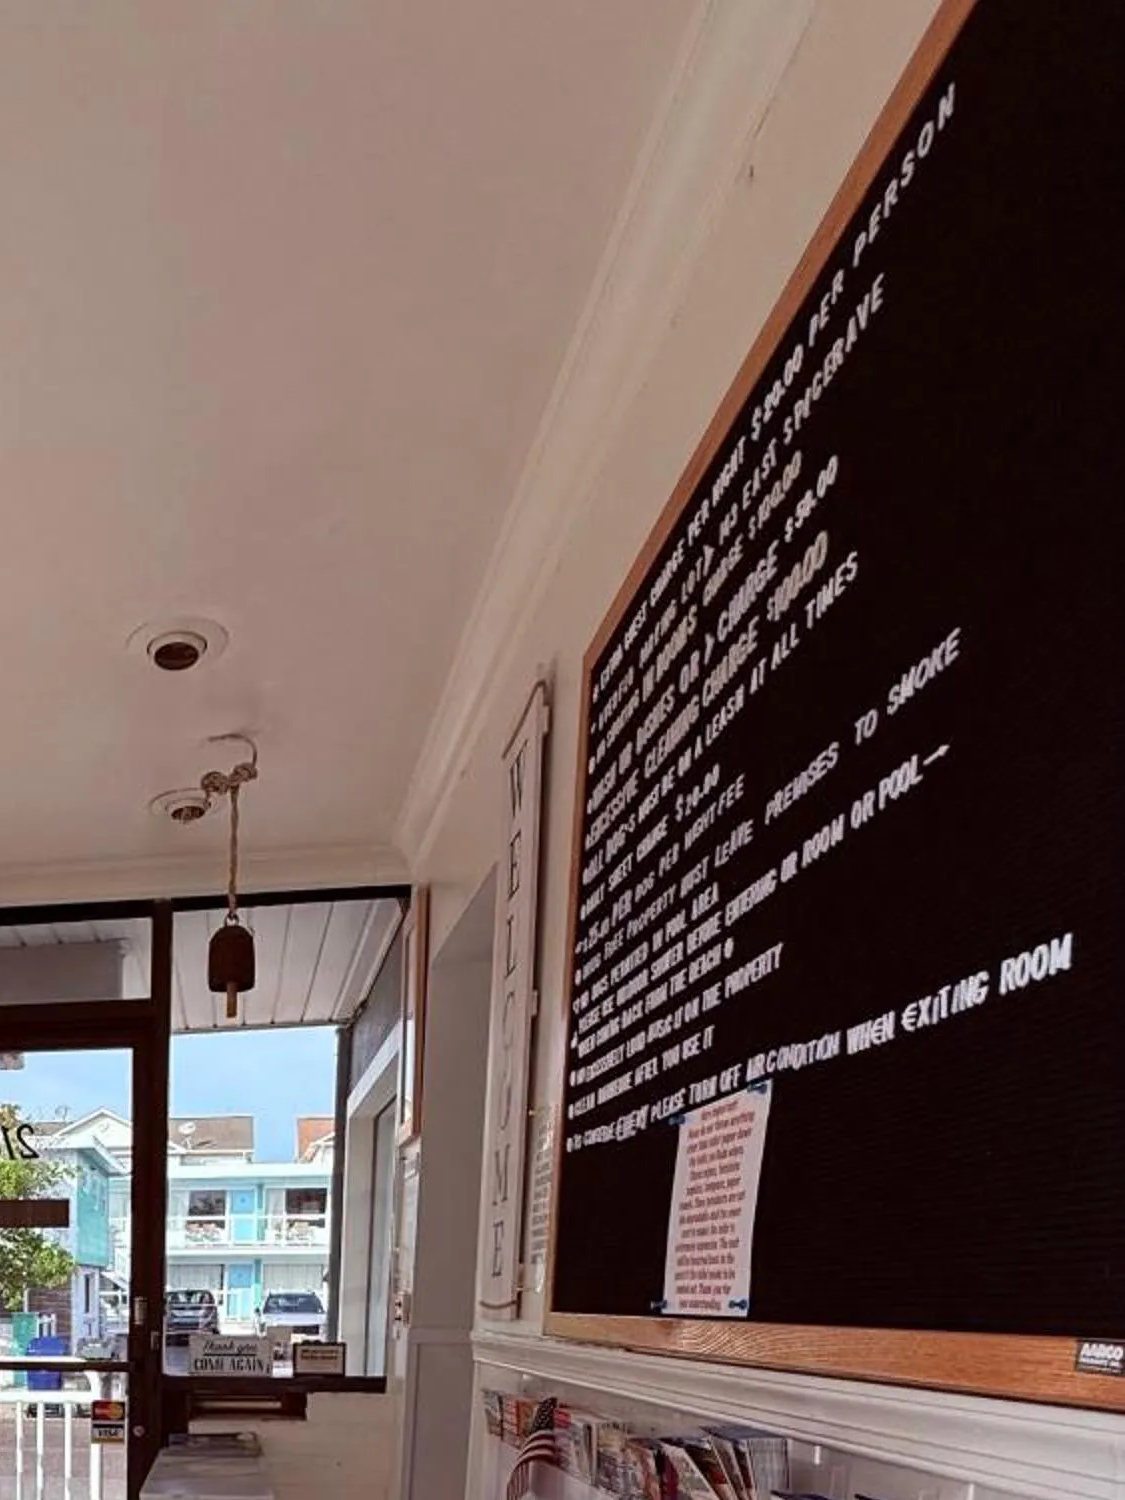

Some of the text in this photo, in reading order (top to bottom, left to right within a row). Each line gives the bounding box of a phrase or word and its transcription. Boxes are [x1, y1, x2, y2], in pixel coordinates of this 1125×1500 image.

[688, 499, 709, 546] PER
[713, 436, 745, 507] NIGHT
[752, 344, 803, 440] $20.00
[809, 270, 843, 346] PER
[853, 84, 955, 266] PERSON
[703, 534, 743, 606] CHARGE
[749, 451, 801, 539] $100.00
[743, 438, 776, 510] EAST
[703, 616, 759, 707] CHARGE
[767, 531, 827, 621] $100.00
[717, 540, 779, 641] CHARGE
[661, 766, 675, 796] BE
[695, 736, 702, 759] A
[706, 684, 744, 746] LEASH
[750, 658, 766, 694] AT
[771, 624, 799, 670] ALL
[806, 552, 857, 628] TIMES
[715, 820, 753, 867] LEAVE
[765, 742, 838, 824] PREMISES
[855, 709, 877, 744] TO
[887, 628, 960, 714] SMOKE
[717, 774, 744, 815] FEE
[802, 814, 844, 867] ROOM
[851, 791, 875, 828] OR
[879, 755, 923, 810] POOL
[725, 942, 783, 998] PROPERTY
[651, 1088, 686, 1122] PLEASE
[689, 1076, 717, 1104] TURN
[720, 1064, 742, 1092] OFF
[847, 1011, 895, 1054] WHEN
[999, 933, 1072, 995] ROOM
[703, 1025, 715, 1049] IT
[193, 1357, 263, 1372] COME AGAIN
